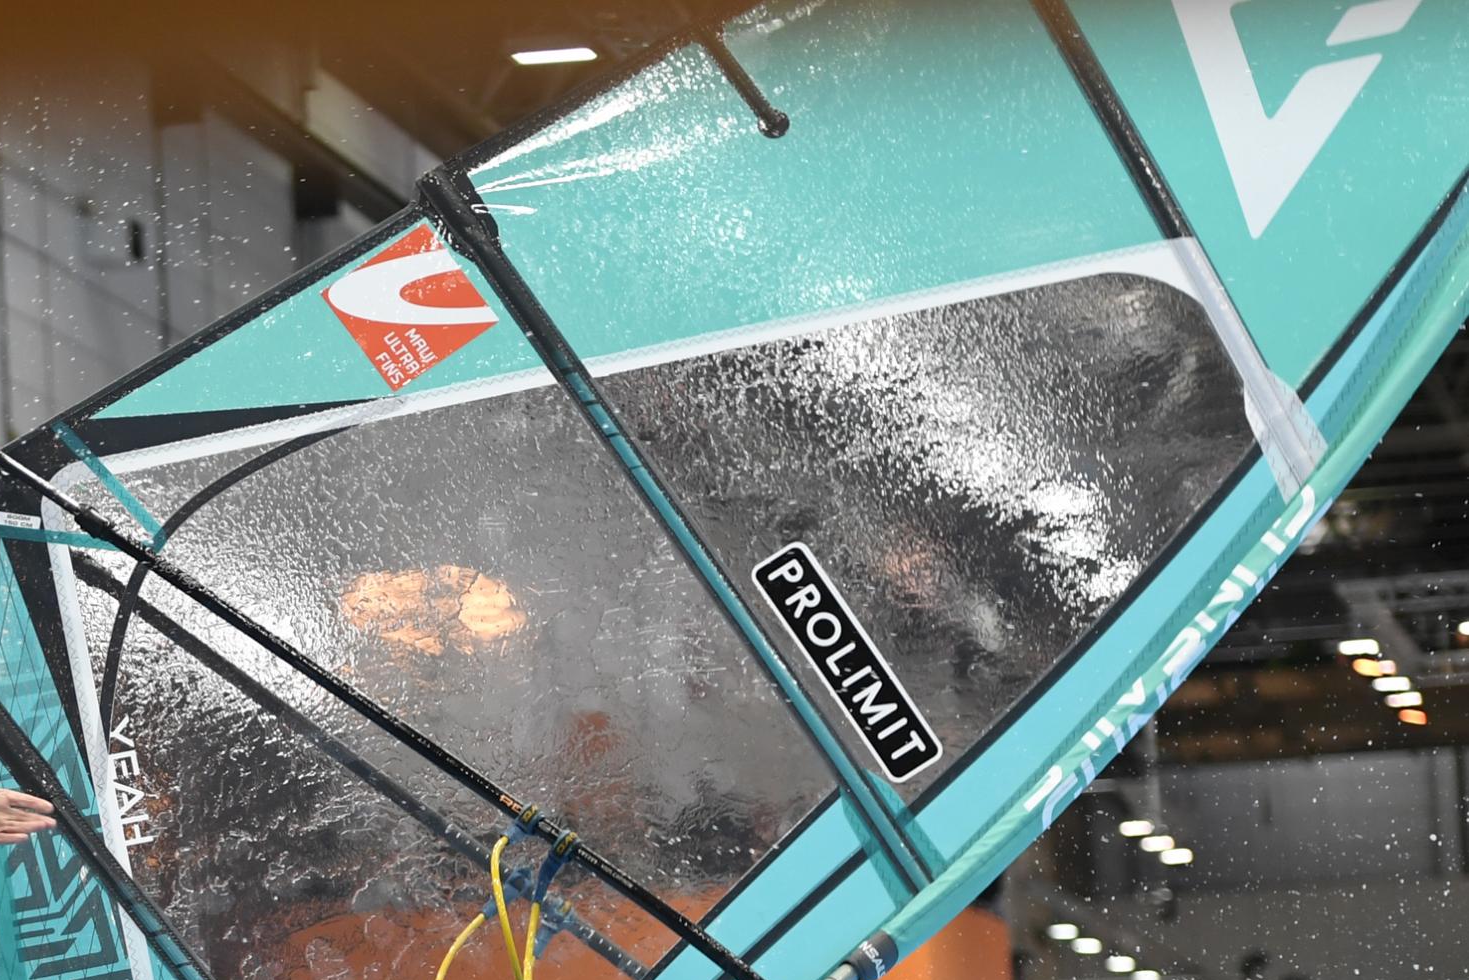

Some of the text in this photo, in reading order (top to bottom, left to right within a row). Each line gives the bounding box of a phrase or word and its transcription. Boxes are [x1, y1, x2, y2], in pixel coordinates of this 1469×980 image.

[383, 331, 420, 374] ULTRA
[404, 328, 438, 363] MAUI
[375, 352, 405, 384] FINS
[767, 558, 927, 761] PROLIMIT
[109, 714, 155, 847] YEAH
